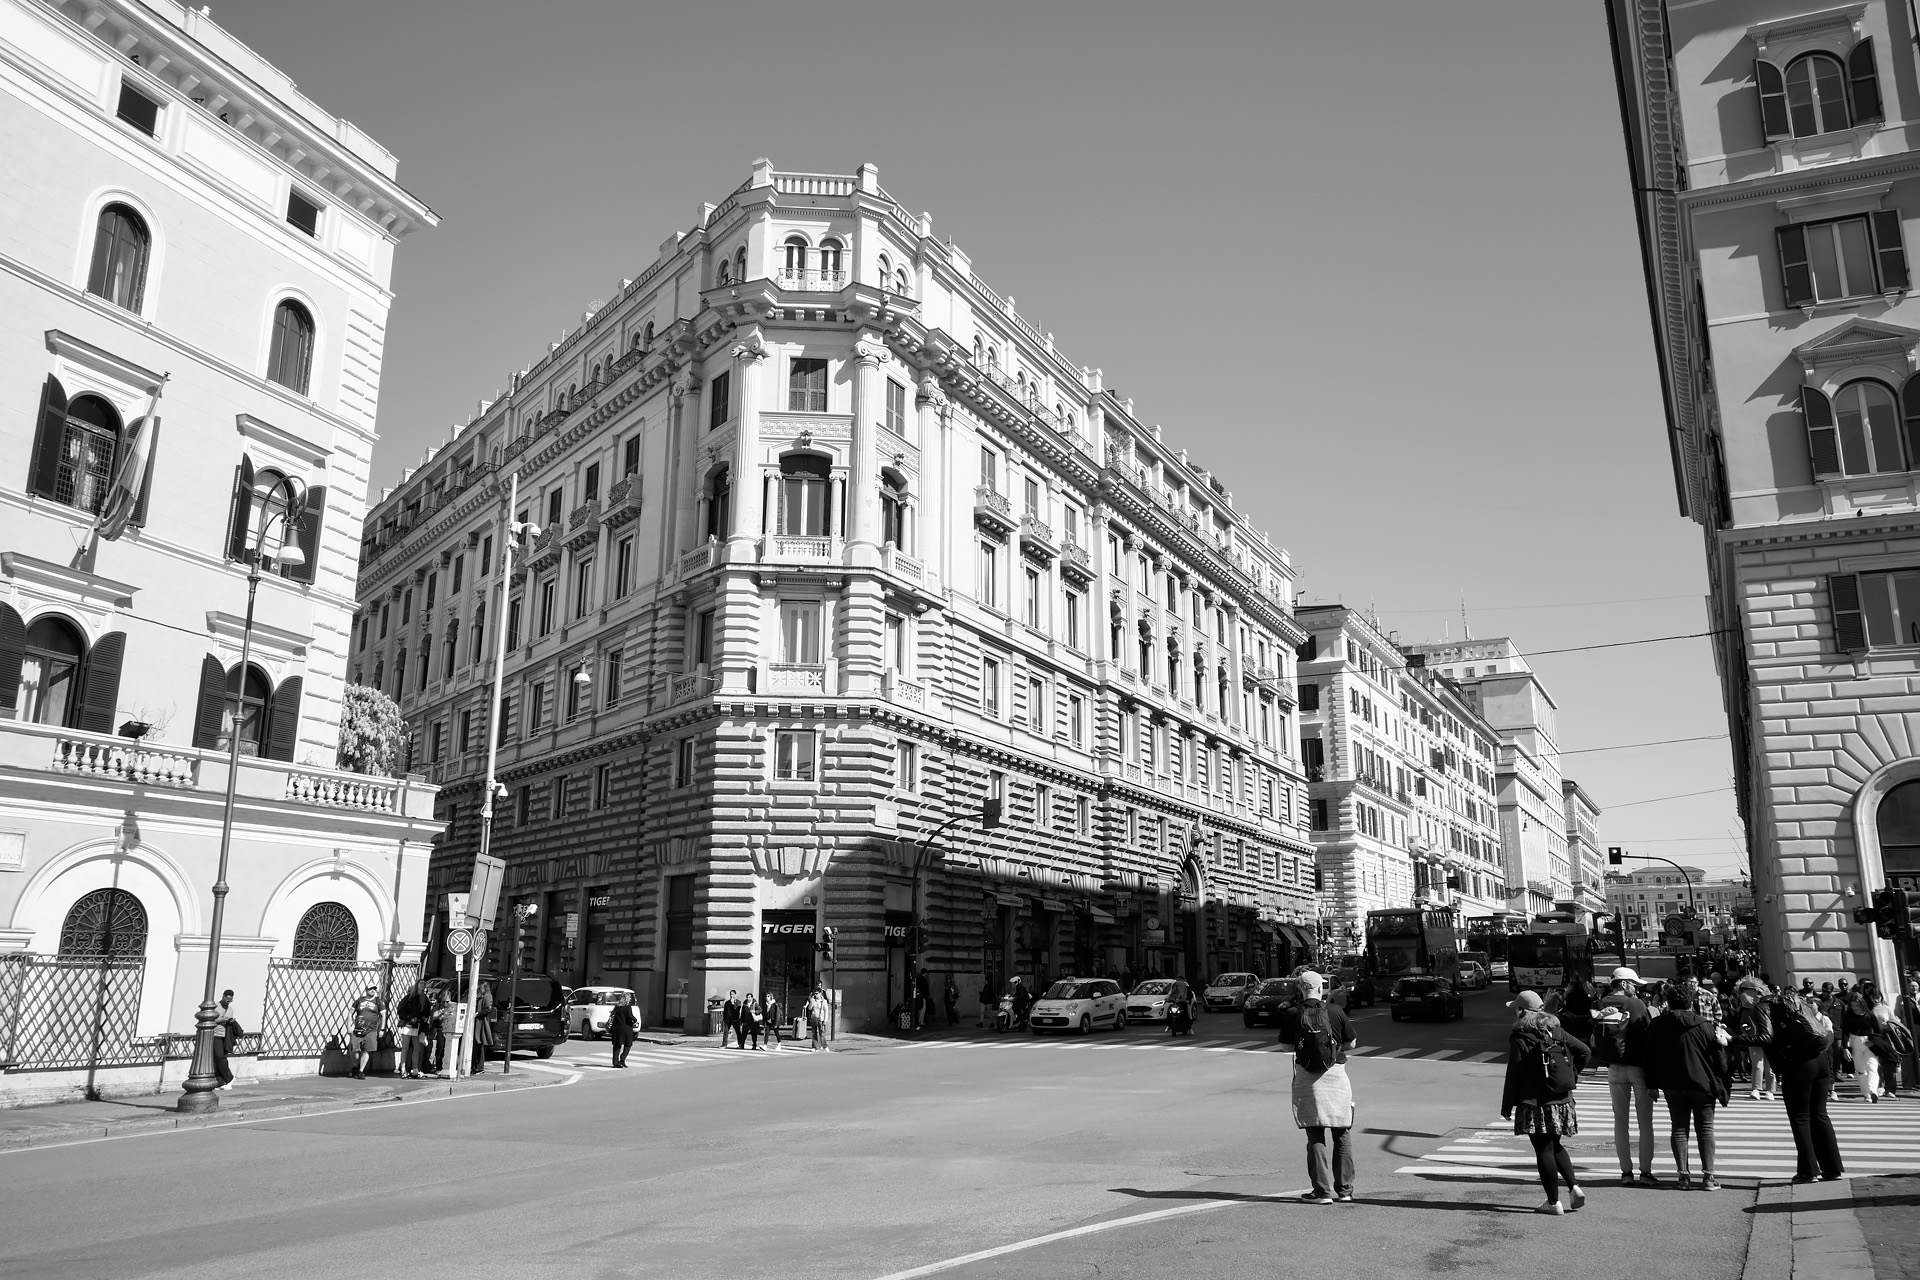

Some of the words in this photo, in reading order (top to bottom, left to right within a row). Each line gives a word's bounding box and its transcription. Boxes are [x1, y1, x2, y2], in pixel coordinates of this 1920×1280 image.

[1898, 877, 1920, 892] B
[762, 923, 816, 934] TIGER
[1627, 916, 1638, 930] P
[884, 925, 907, 937] TIGE
